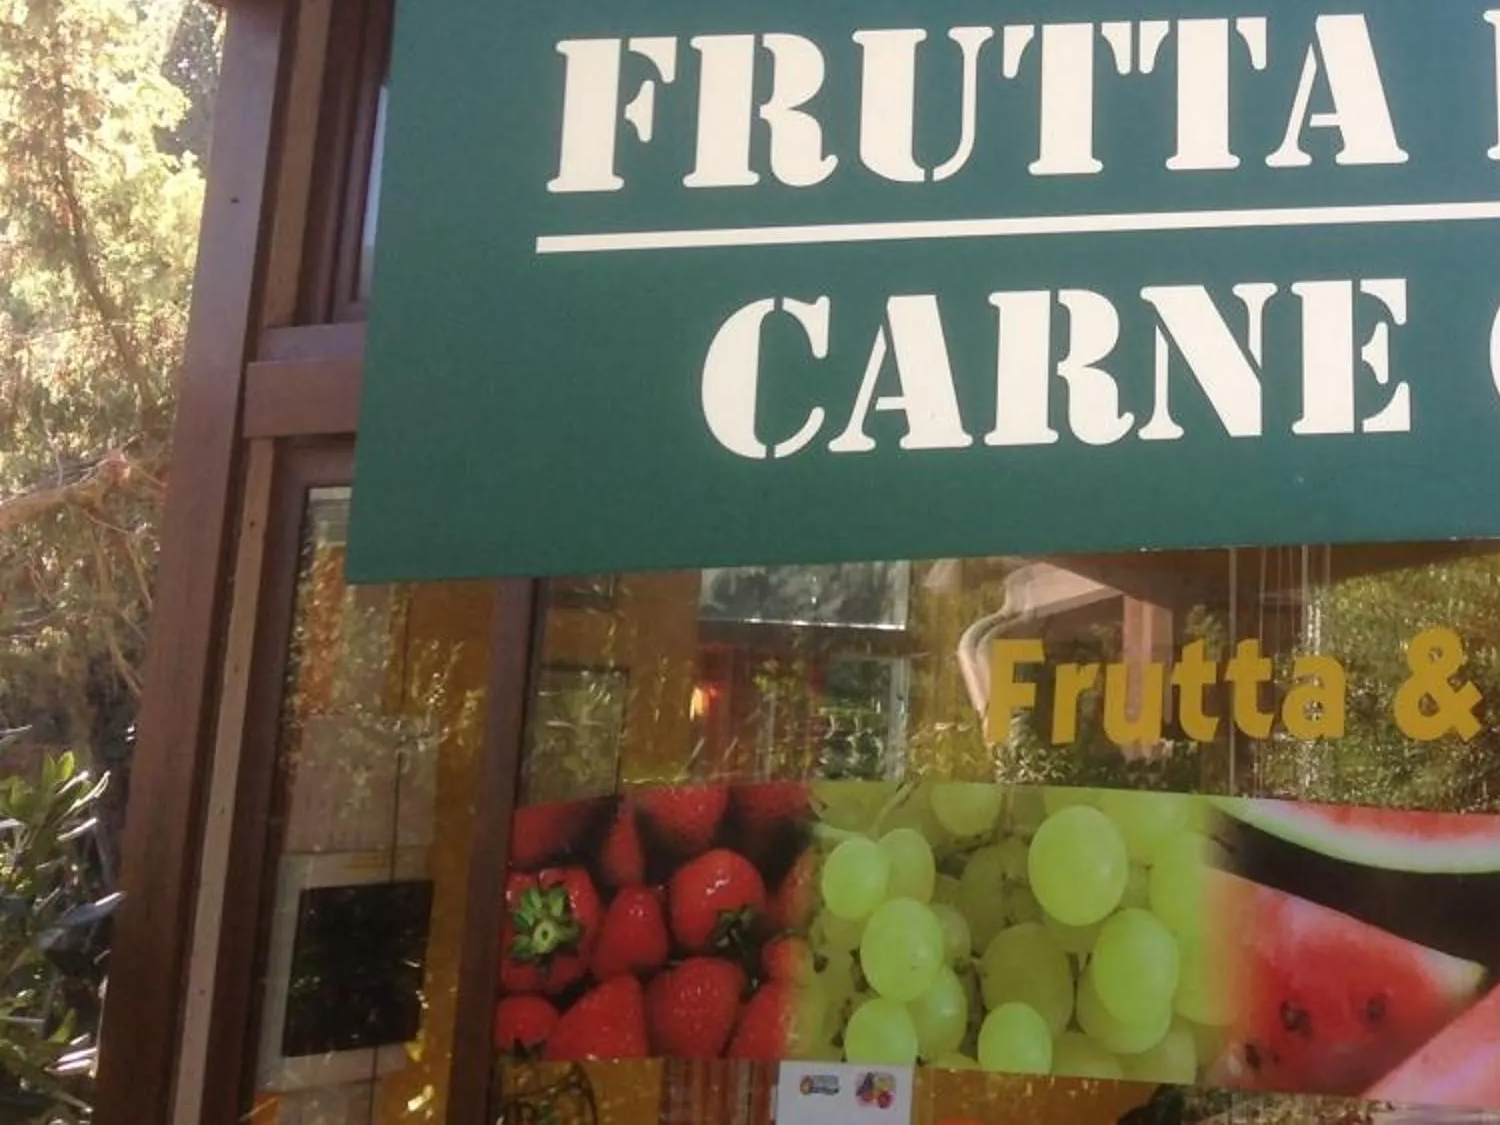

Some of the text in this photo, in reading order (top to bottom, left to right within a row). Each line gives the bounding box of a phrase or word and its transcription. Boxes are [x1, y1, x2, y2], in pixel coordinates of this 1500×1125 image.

[546, 12, 1410, 194] FRUTTA
[700, 277, 1412, 462] CARNE
[985, 636, 1350, 749] Frutta
[1393, 627, 1484, 743] &
